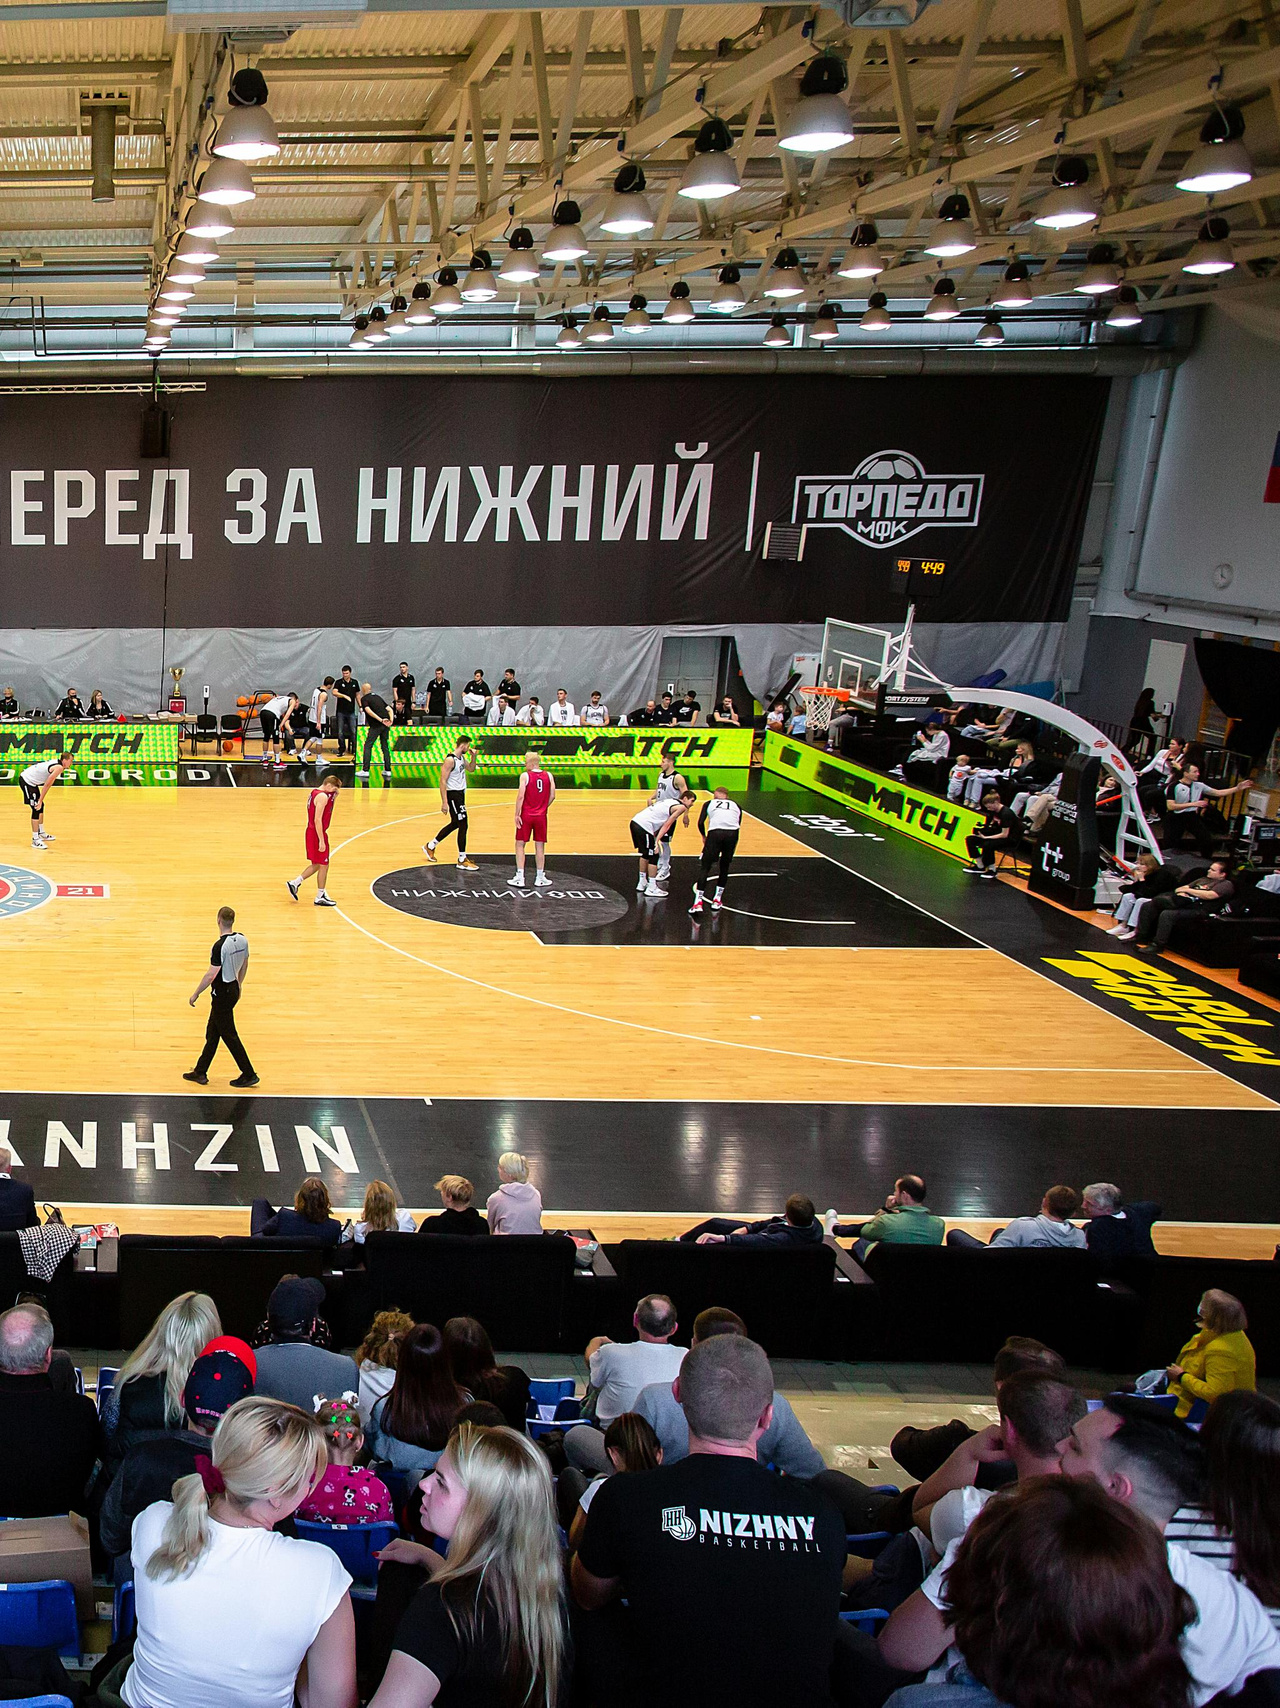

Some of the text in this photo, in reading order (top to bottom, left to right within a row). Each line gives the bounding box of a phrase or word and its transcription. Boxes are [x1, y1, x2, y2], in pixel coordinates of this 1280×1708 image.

[224, 467, 322, 545] ЗА
[355, 441, 715, 545] НИЖНИЙ
[804, 484, 974, 519] ТОРПЕДО
[857, 520, 909, 542] МФК
[6, 732, 144, 754] MATCH
[578, 736, 718, 758] MATCH
[536, 779, 543, 793] 9
[867, 783, 960, 841] MATCH
[1051, 868, 1071, 882] group
[66, 886, 97, 895] 21
[391, 888, 543, 899] НИЖНИЙ
[1075, 950, 1274, 1027] PARI
[1040, 957, 1280, 1066] MATCH
[699, 1508, 815, 1541] NIZHNY
[699, 1534, 822, 1553] BASKETBALL
